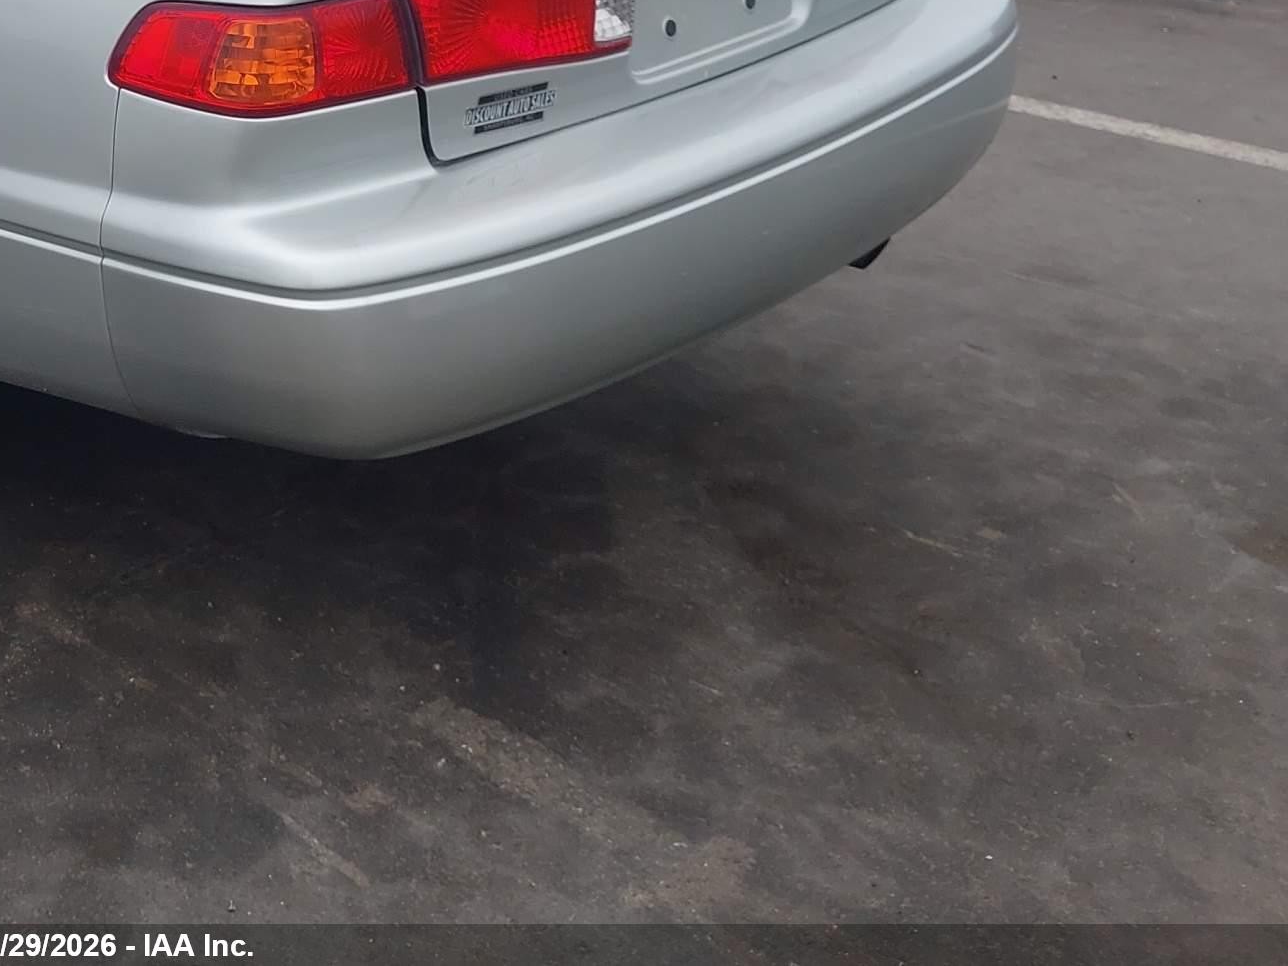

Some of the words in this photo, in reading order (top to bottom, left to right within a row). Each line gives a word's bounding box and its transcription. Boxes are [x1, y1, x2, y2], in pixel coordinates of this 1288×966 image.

[464, 101, 509, 125] DISCOUNT
[508, 95, 531, 114] AUTO
[531, 90, 557, 110] SALES
